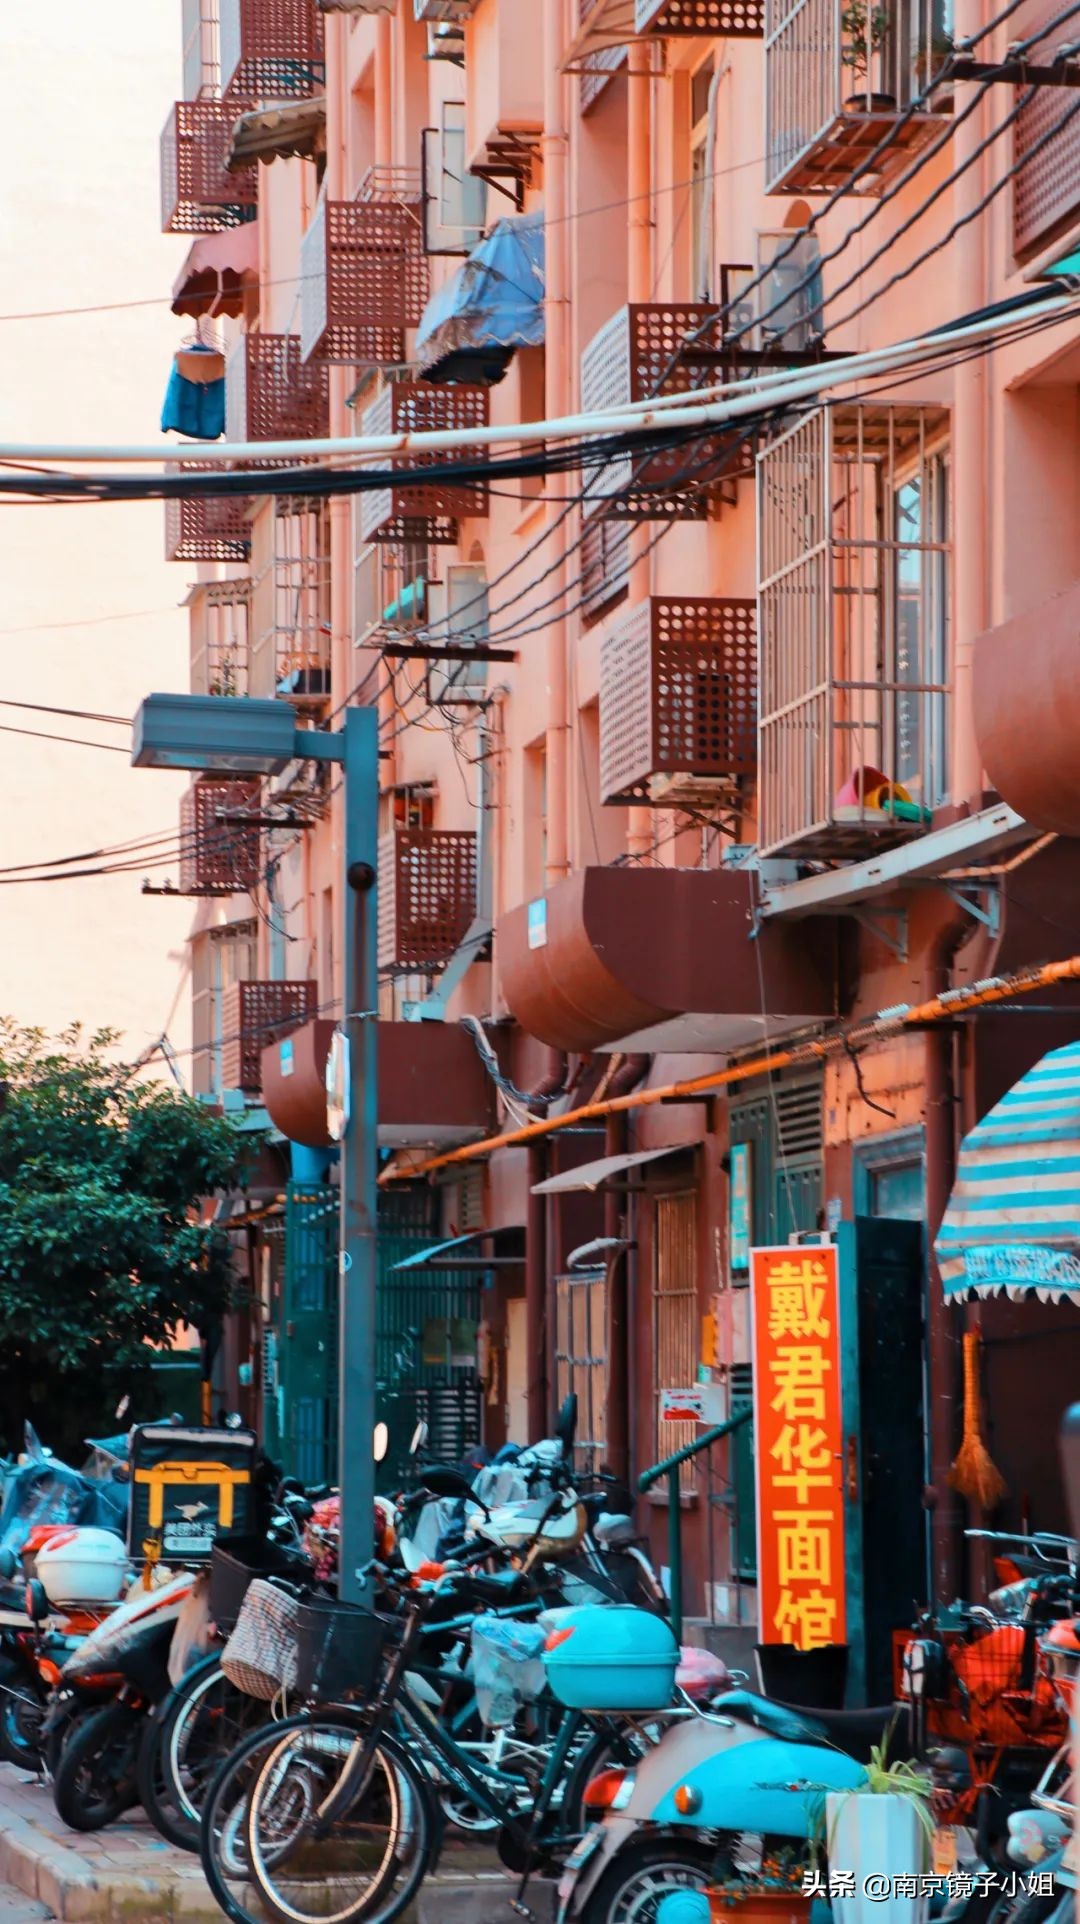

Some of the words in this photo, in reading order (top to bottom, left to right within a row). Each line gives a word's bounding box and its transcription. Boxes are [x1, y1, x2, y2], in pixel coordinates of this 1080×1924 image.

[766, 1259, 837, 1651] 戴君华面馆
